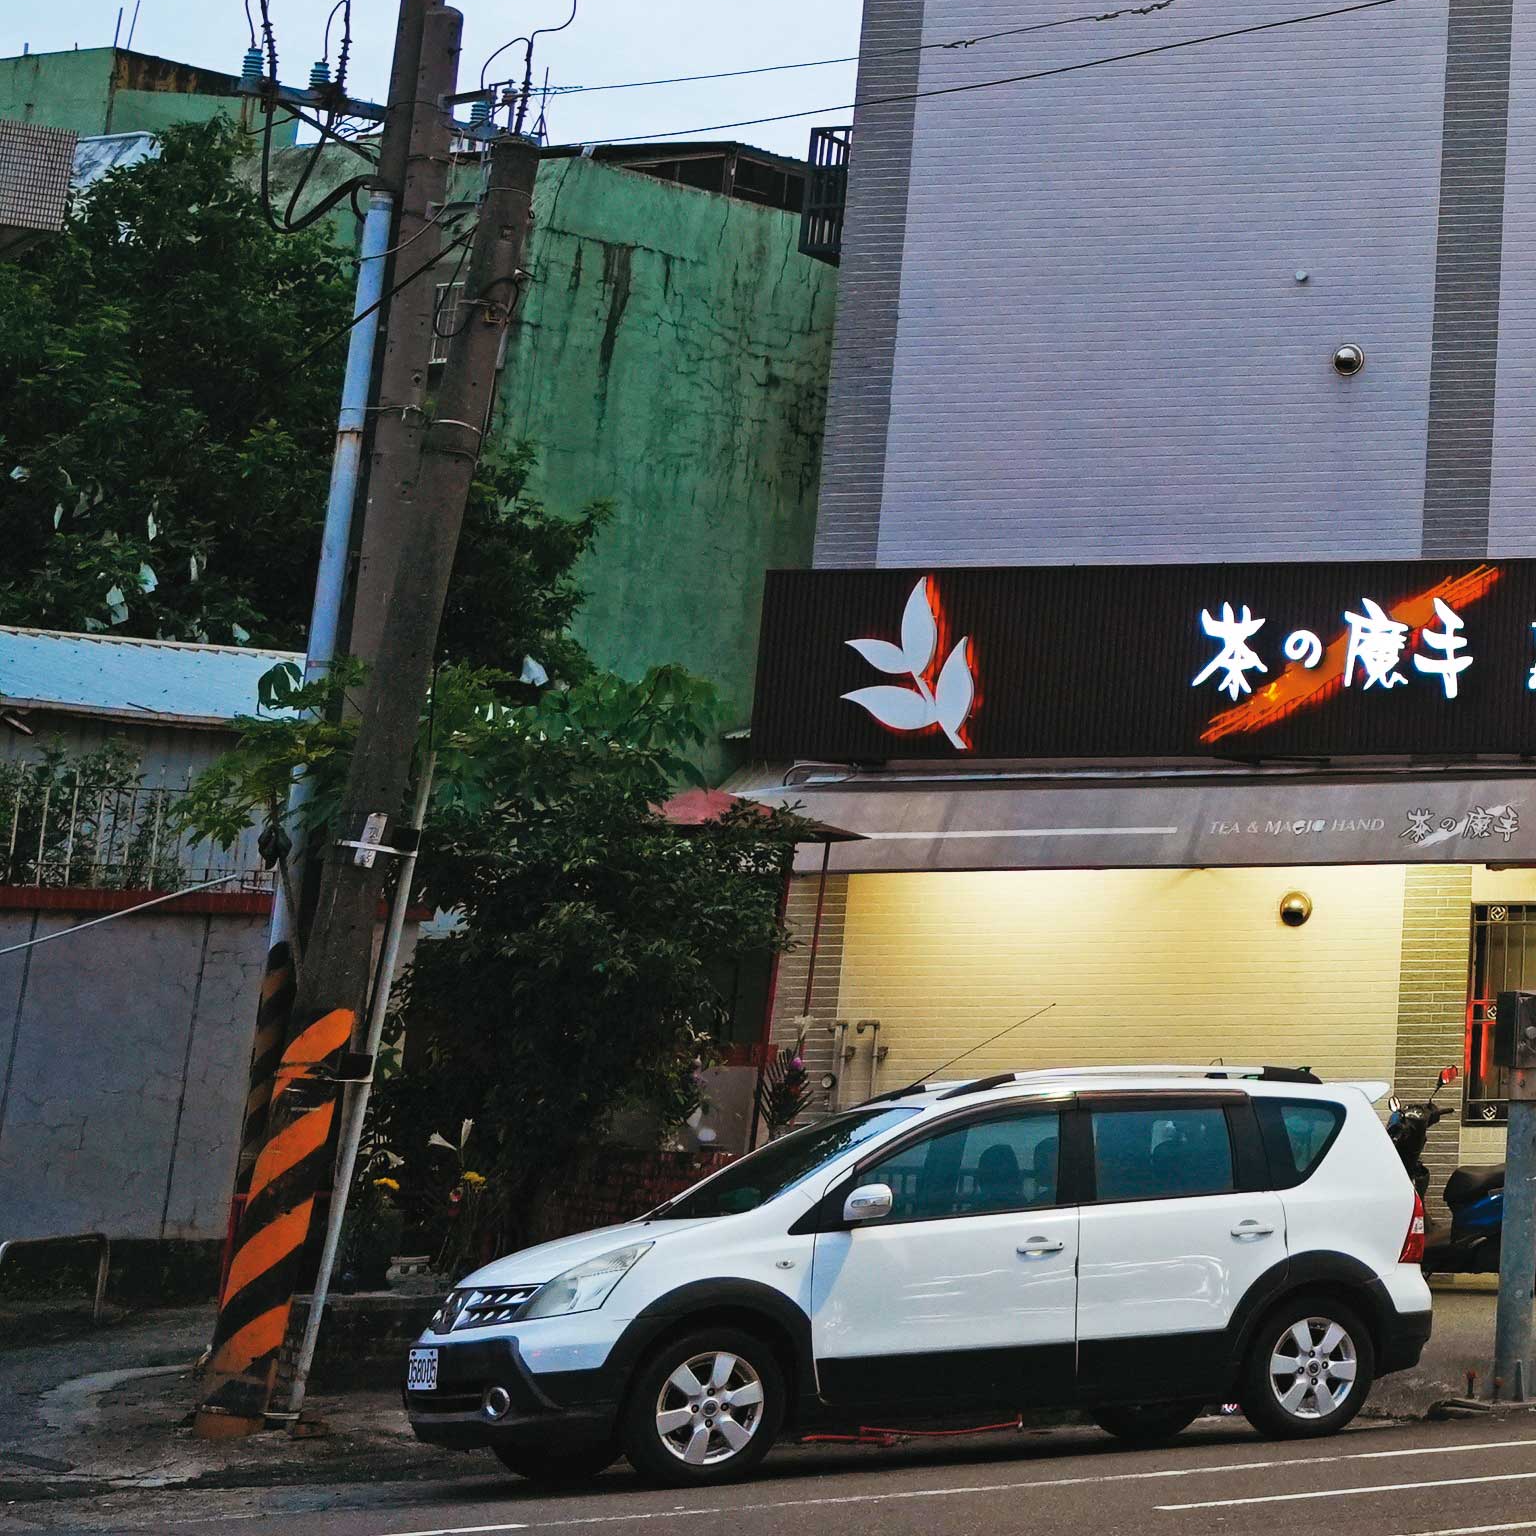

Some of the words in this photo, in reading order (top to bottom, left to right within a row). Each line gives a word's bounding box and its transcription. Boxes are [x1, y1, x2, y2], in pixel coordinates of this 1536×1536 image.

[1193, 597, 1474, 700] 茶の魔手
[1210, 821, 1240, 835] TEA
[1247, 822, 1259, 835] &
[1331, 817, 1385, 832] HAND
[1401, 805, 1519, 842] 茶の魔手
